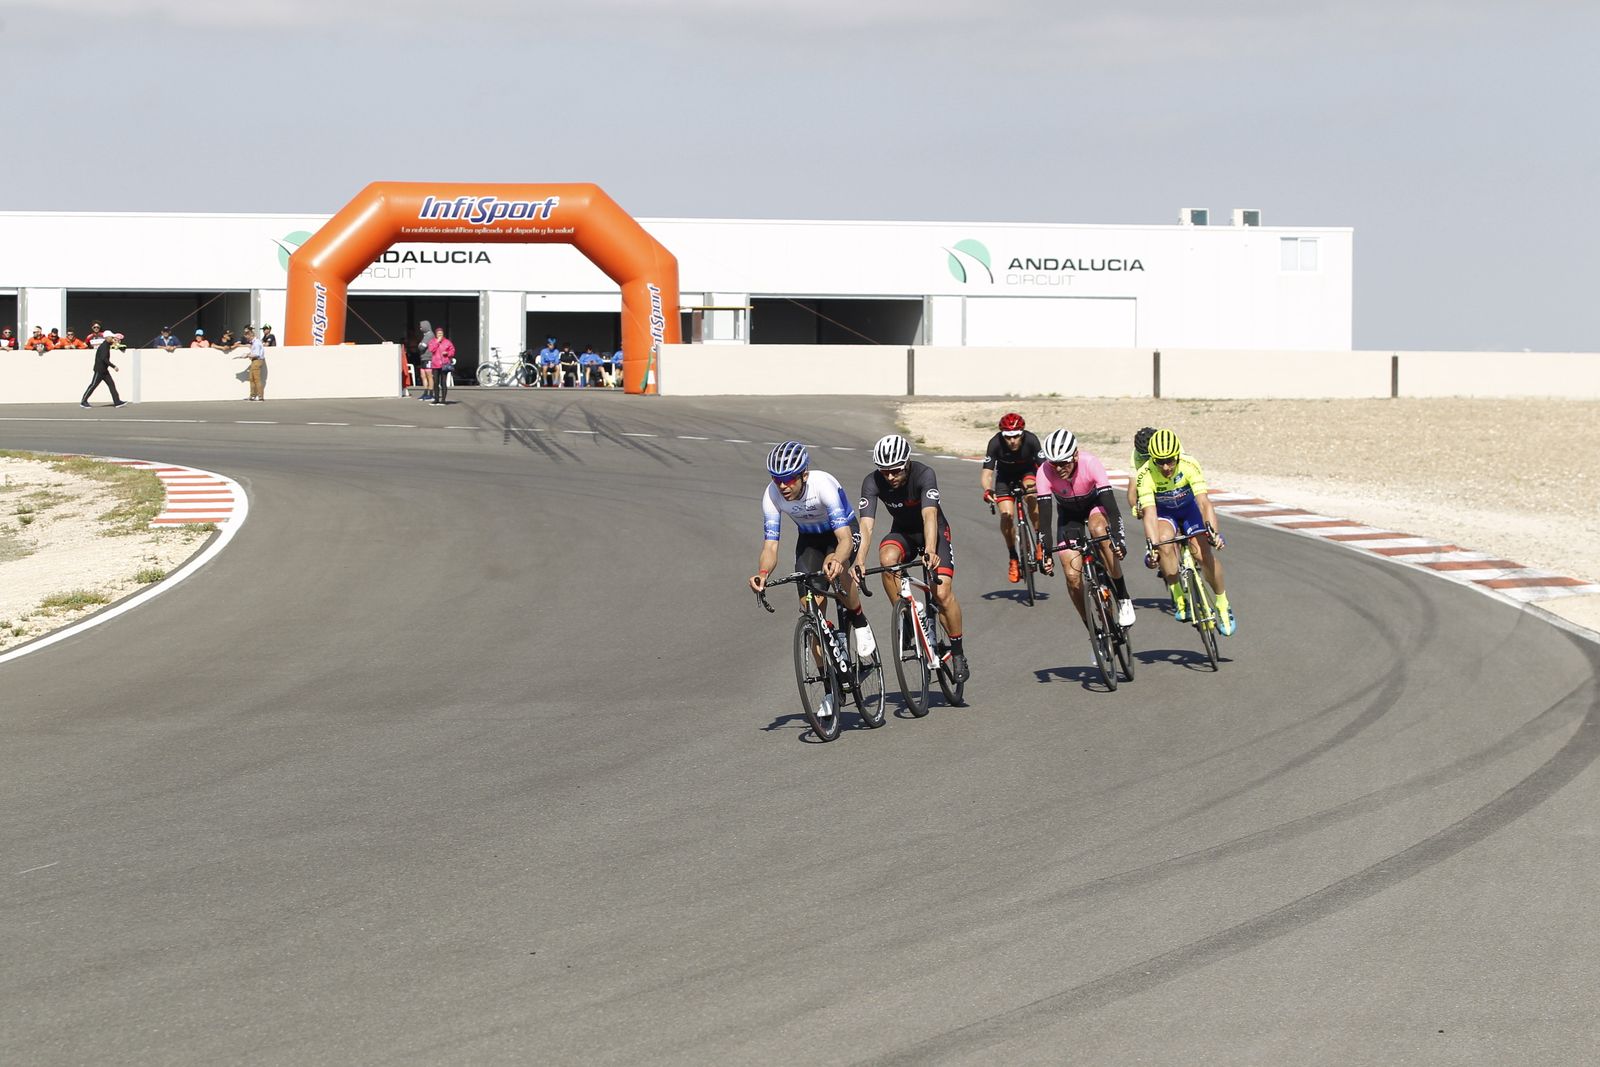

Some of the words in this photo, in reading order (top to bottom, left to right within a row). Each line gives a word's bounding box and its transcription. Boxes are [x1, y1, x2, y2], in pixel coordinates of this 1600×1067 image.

[418, 196, 560, 225] InfiSport
[375, 251, 491, 264] DALUCIA
[1008, 257, 1145, 271] ANDALUCIA
[360, 267, 416, 278] RCUIT
[1006, 273, 1075, 286] CIRCUIT
[312, 281, 328, 346] nfiSport
